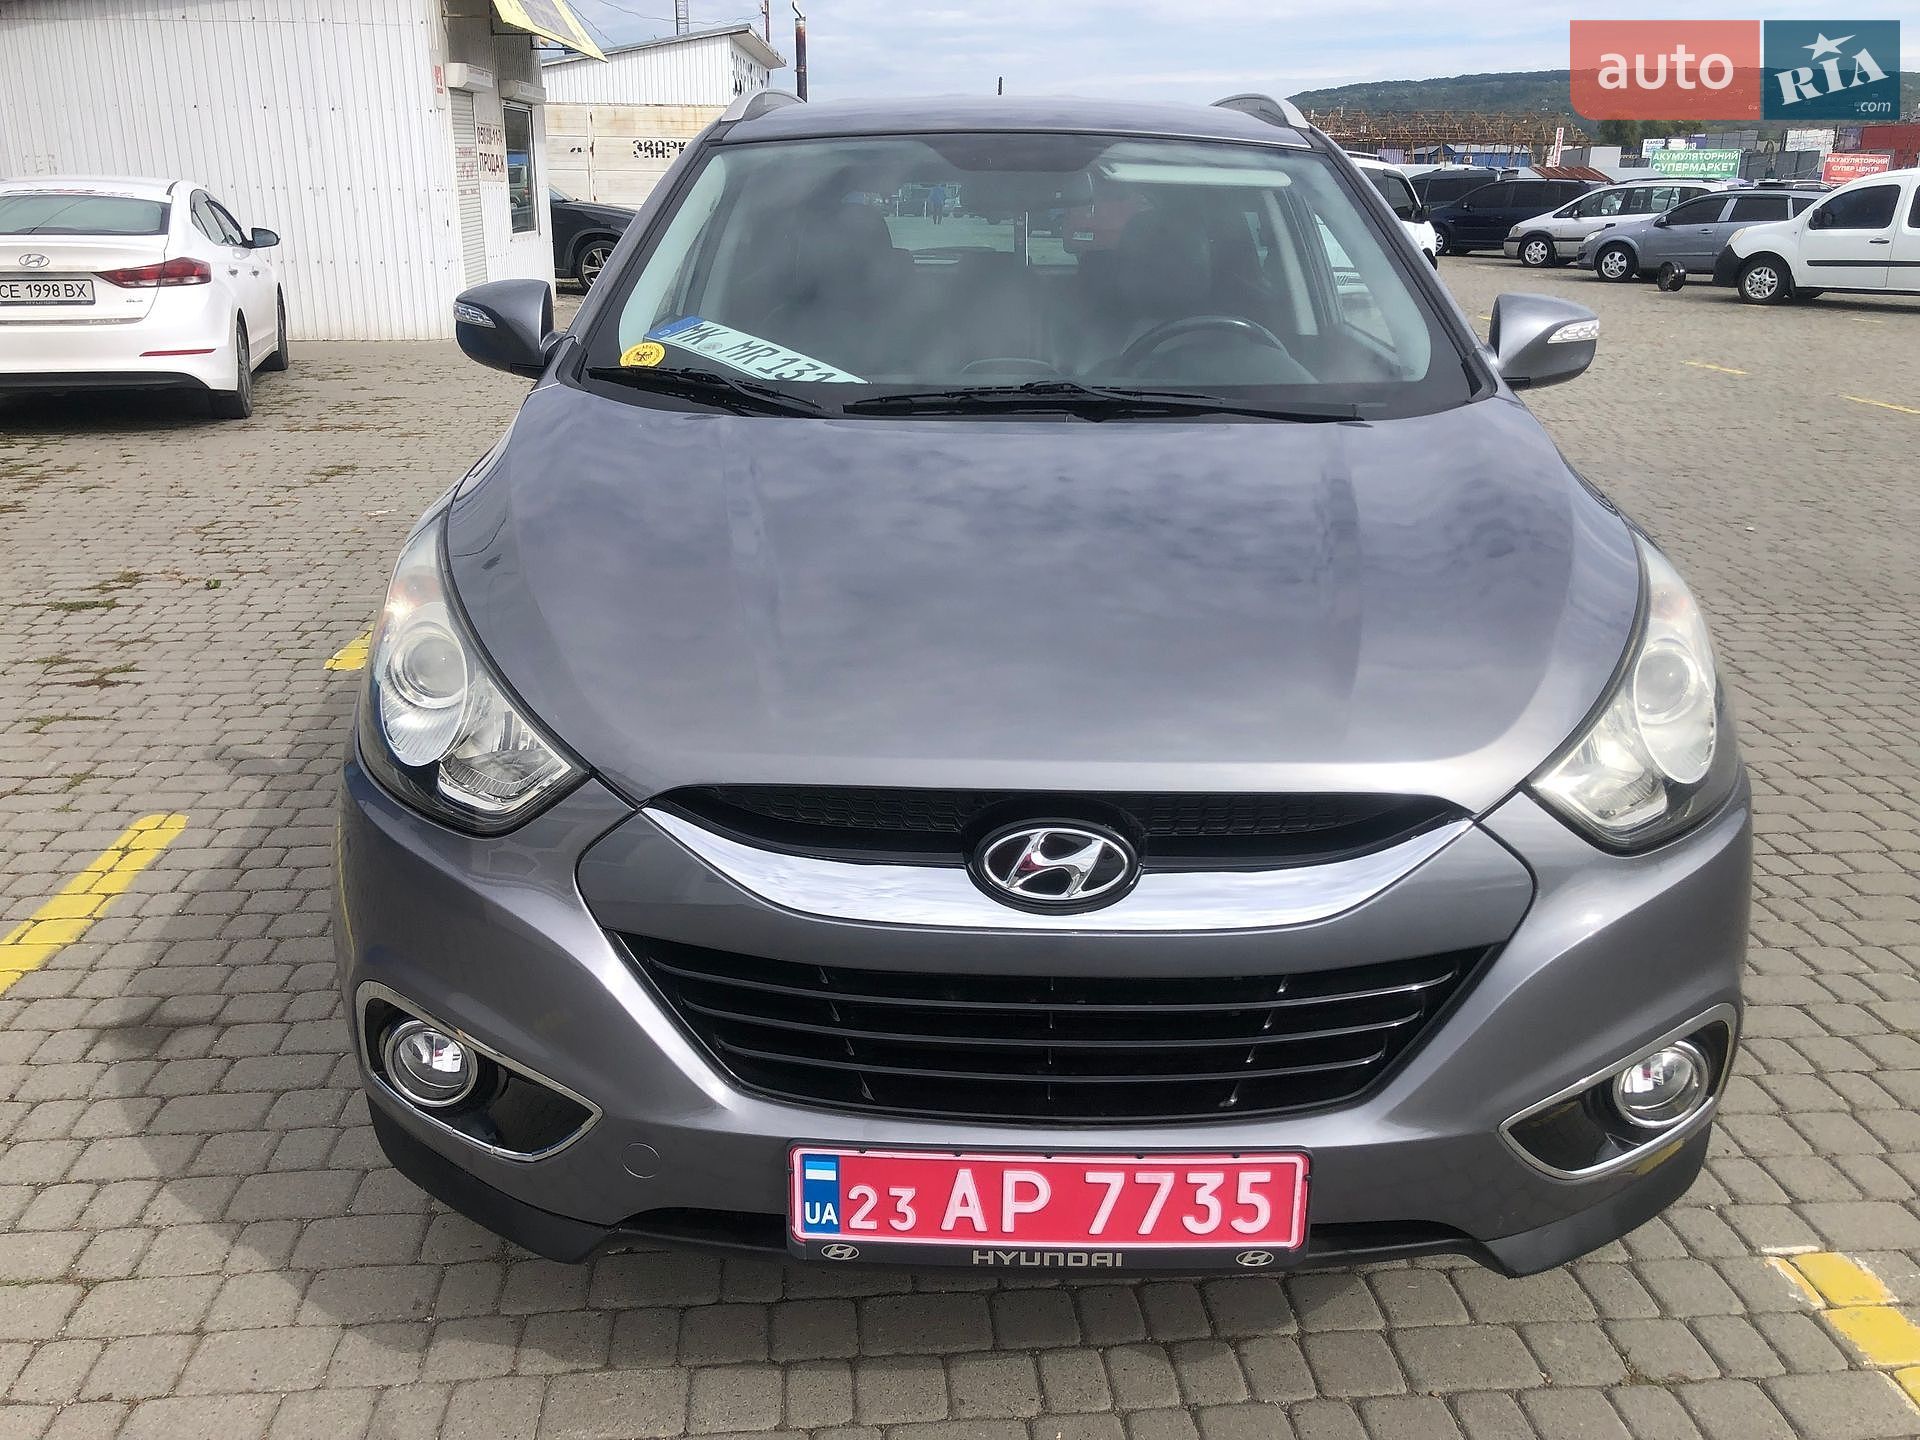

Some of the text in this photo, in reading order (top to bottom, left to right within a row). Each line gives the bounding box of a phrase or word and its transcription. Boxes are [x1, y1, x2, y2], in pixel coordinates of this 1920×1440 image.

[1652, 150, 1739, 161] АКУМУЛЯТОРНИЙ
[1652, 162, 1736, 172] СУПЕРМАРКЕТ
[0, 283, 88, 298] CE 1998 BX
[847, 1168, 1272, 1236] 23 AP 7735
[804, 1201, 839, 1225] UA
[972, 1249, 1123, 1268] HYUNDAI
